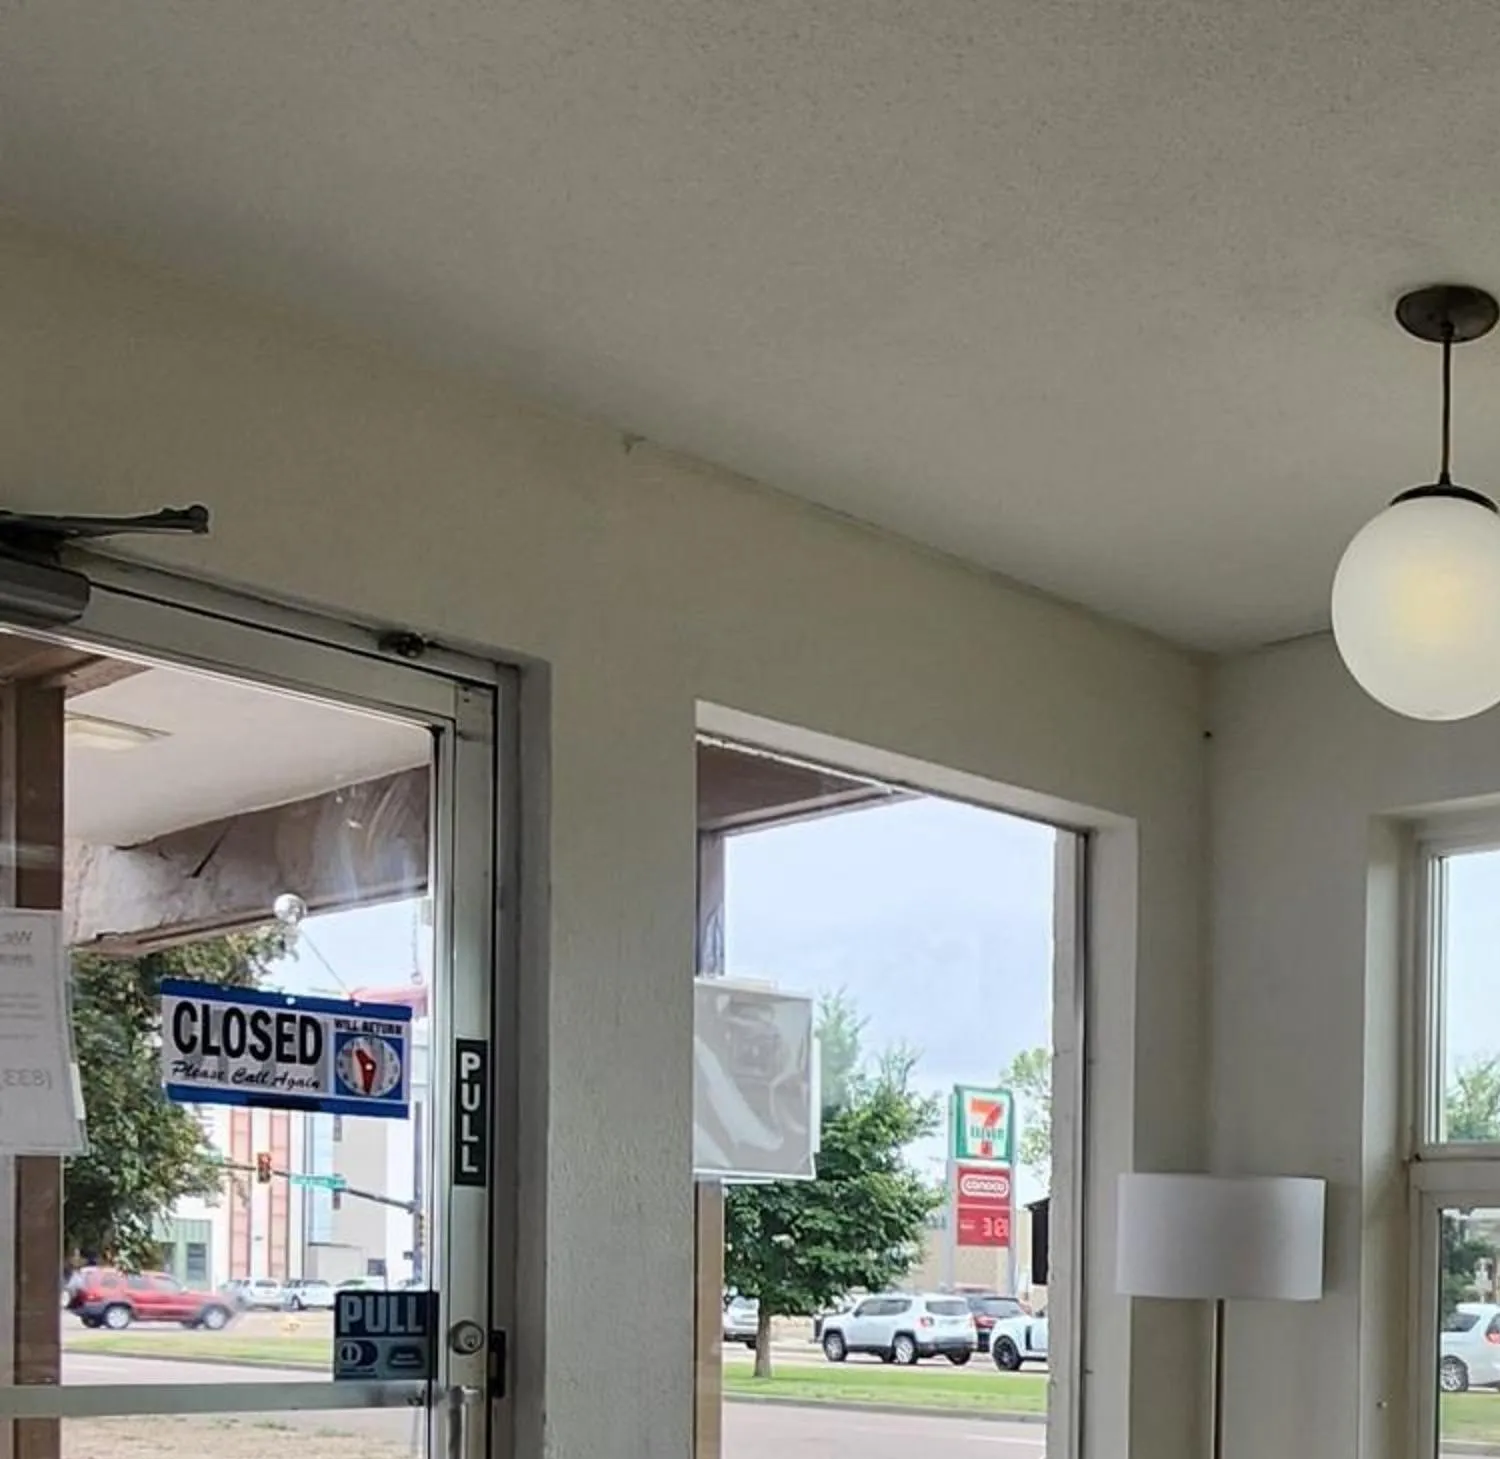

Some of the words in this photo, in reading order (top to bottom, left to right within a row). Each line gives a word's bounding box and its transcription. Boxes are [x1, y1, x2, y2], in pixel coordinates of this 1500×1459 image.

[173, 1001, 323, 1066] CLOSED
[171, 1059, 225, 1081] Please
[231, 1066, 270, 1085] Call
[271, 1071, 321, 1091] Again
[460, 1052, 481, 1173] PULL
[340, 1295, 423, 1333] PULL
